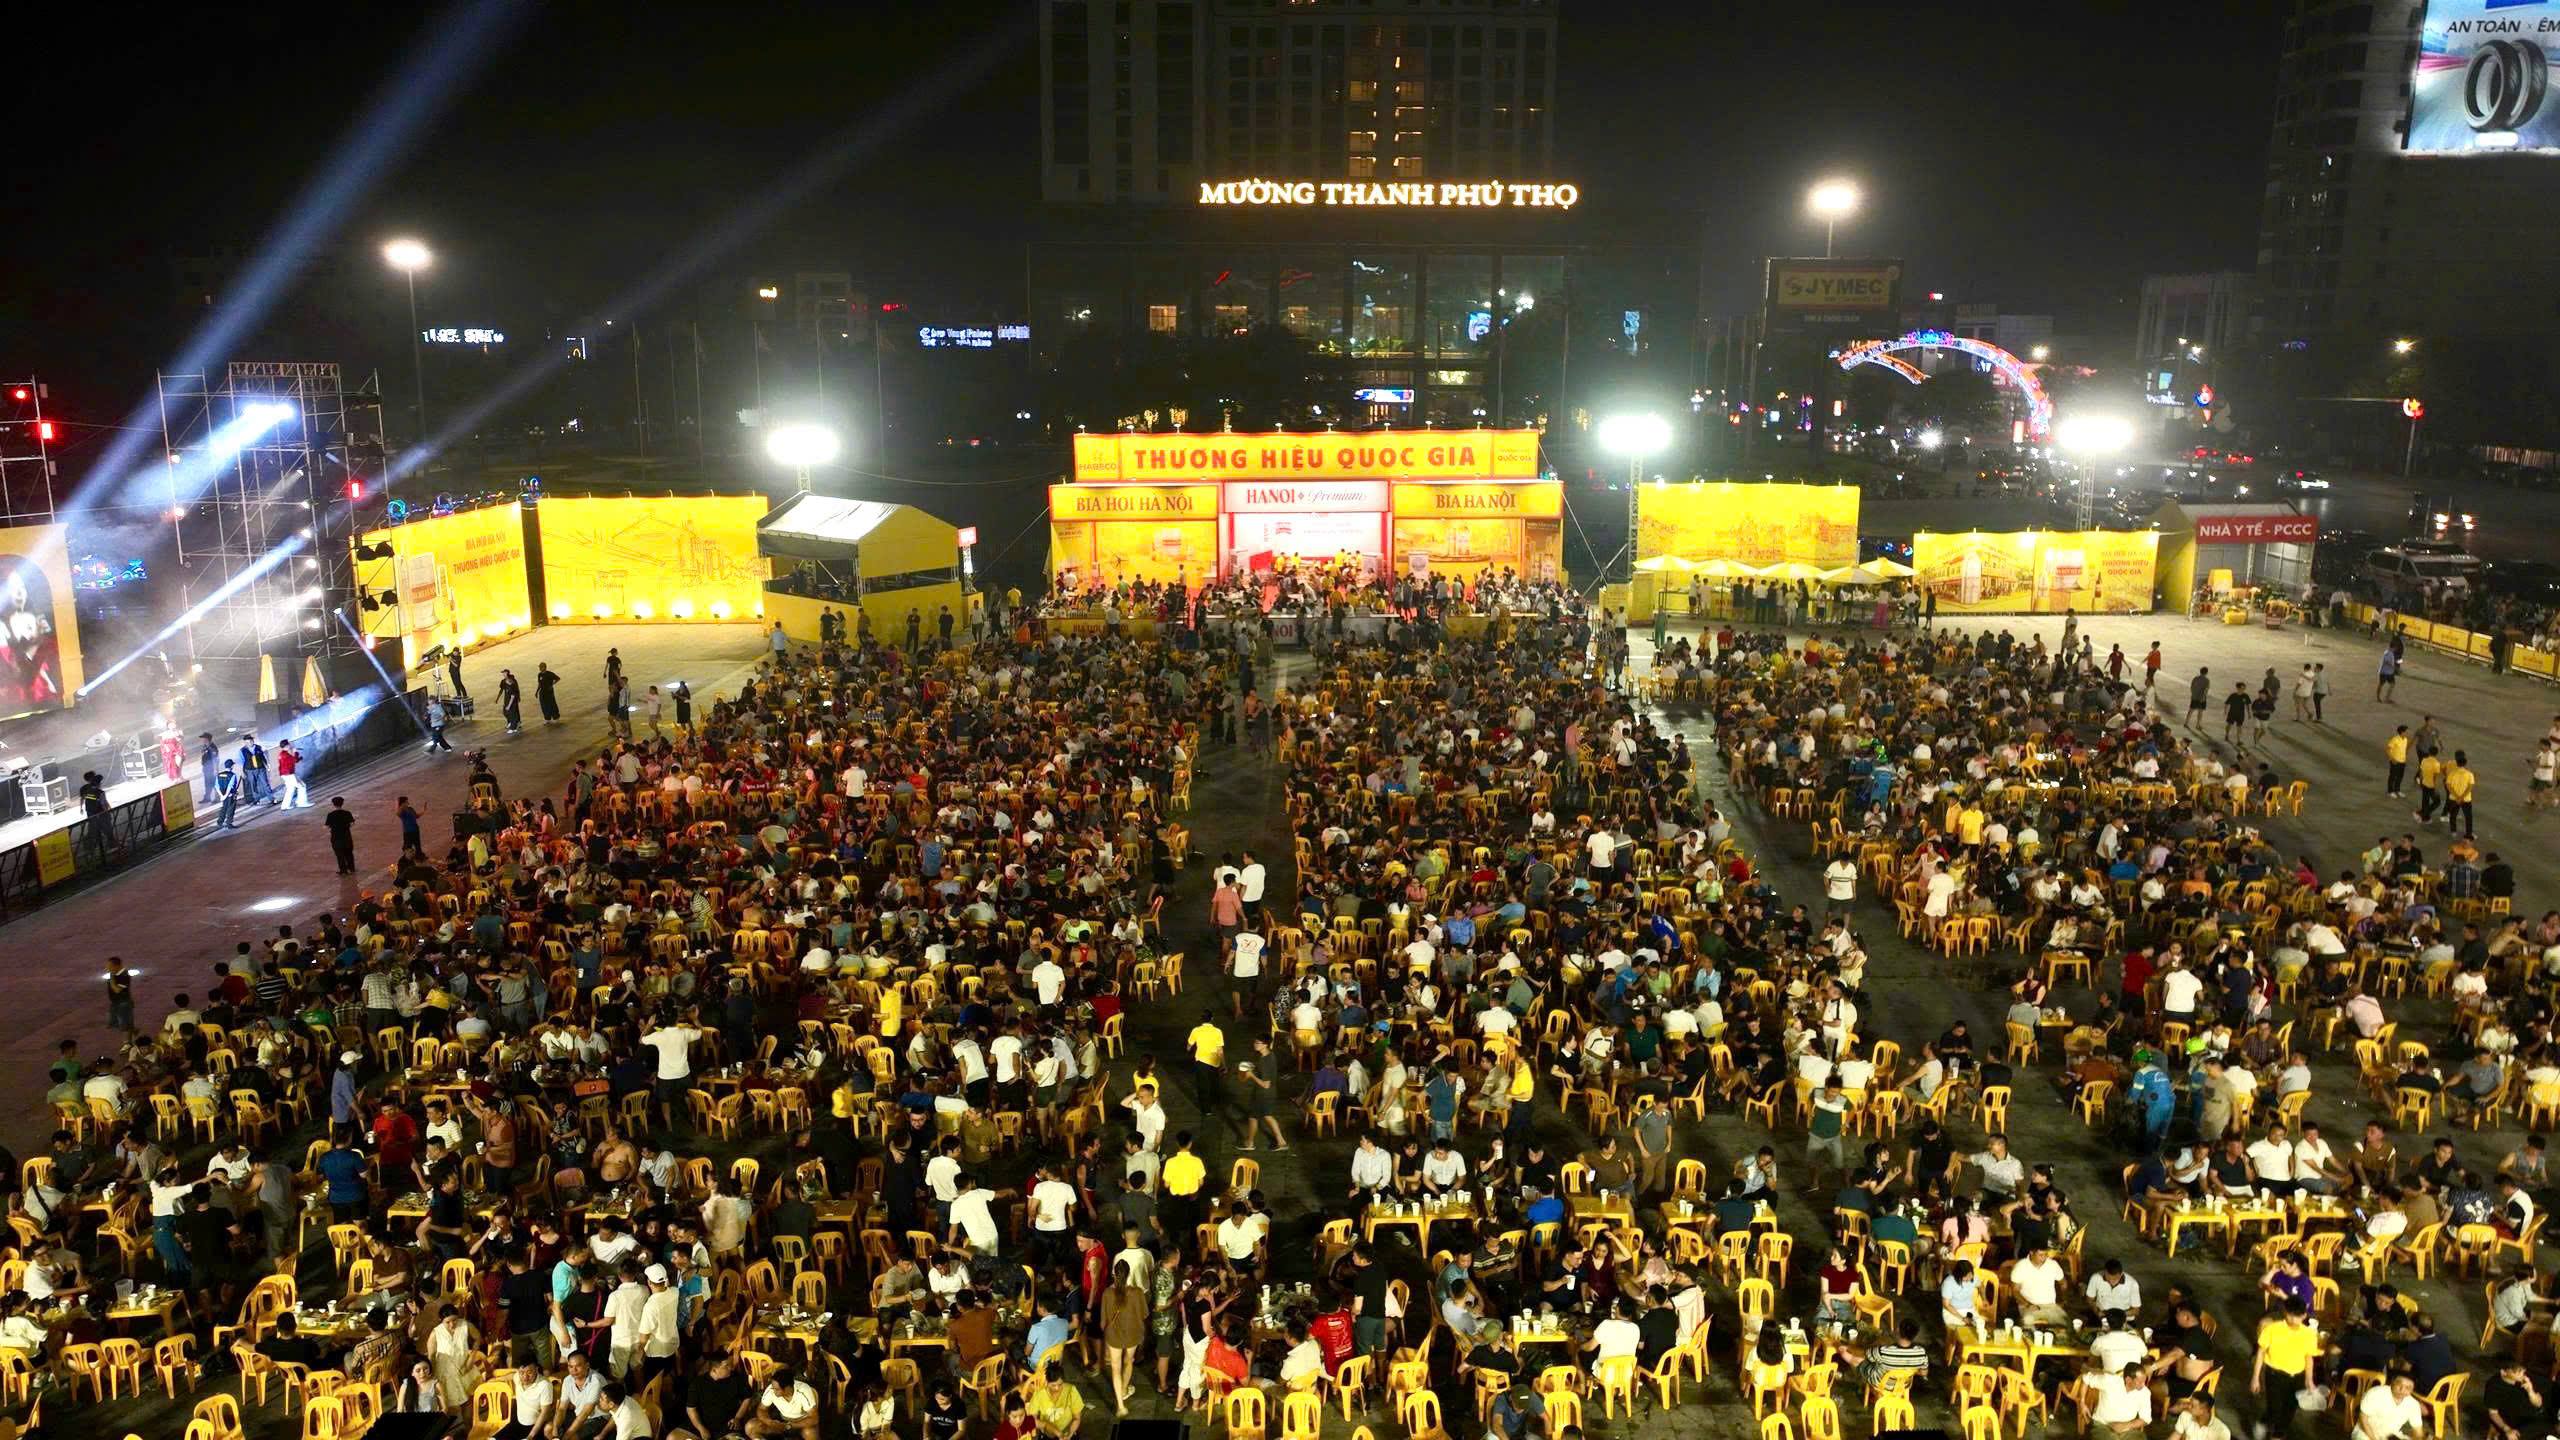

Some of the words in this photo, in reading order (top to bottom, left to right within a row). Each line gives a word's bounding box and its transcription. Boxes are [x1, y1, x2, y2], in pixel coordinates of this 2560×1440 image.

[2447, 21, 2472, 32] AN
[2476, 17, 2521, 32] TOÀN
[1199, 177, 1316, 204] MƯỜNG
[1320, 182, 1434, 205] THANH
[1439, 179, 1505, 206] PHÚ
[1508, 184, 1578, 210] THỌ
[1261, 444, 1323, 471] HIỆU
[1428, 446, 1475, 467] GIA
[1076, 495, 1101, 511] BIA
[1165, 492, 1194, 514] NỘI
[1247, 488, 1295, 504] HANOI
[1436, 494, 1460, 508] BIA
[1488, 490, 1516, 511] NỘI
[2200, 522, 2231, 536] NHÀ
[2234, 525, 2244, 536] Y
[2246, 520, 2265, 536] TẾ
[2274, 523, 2312, 536] PCCC
